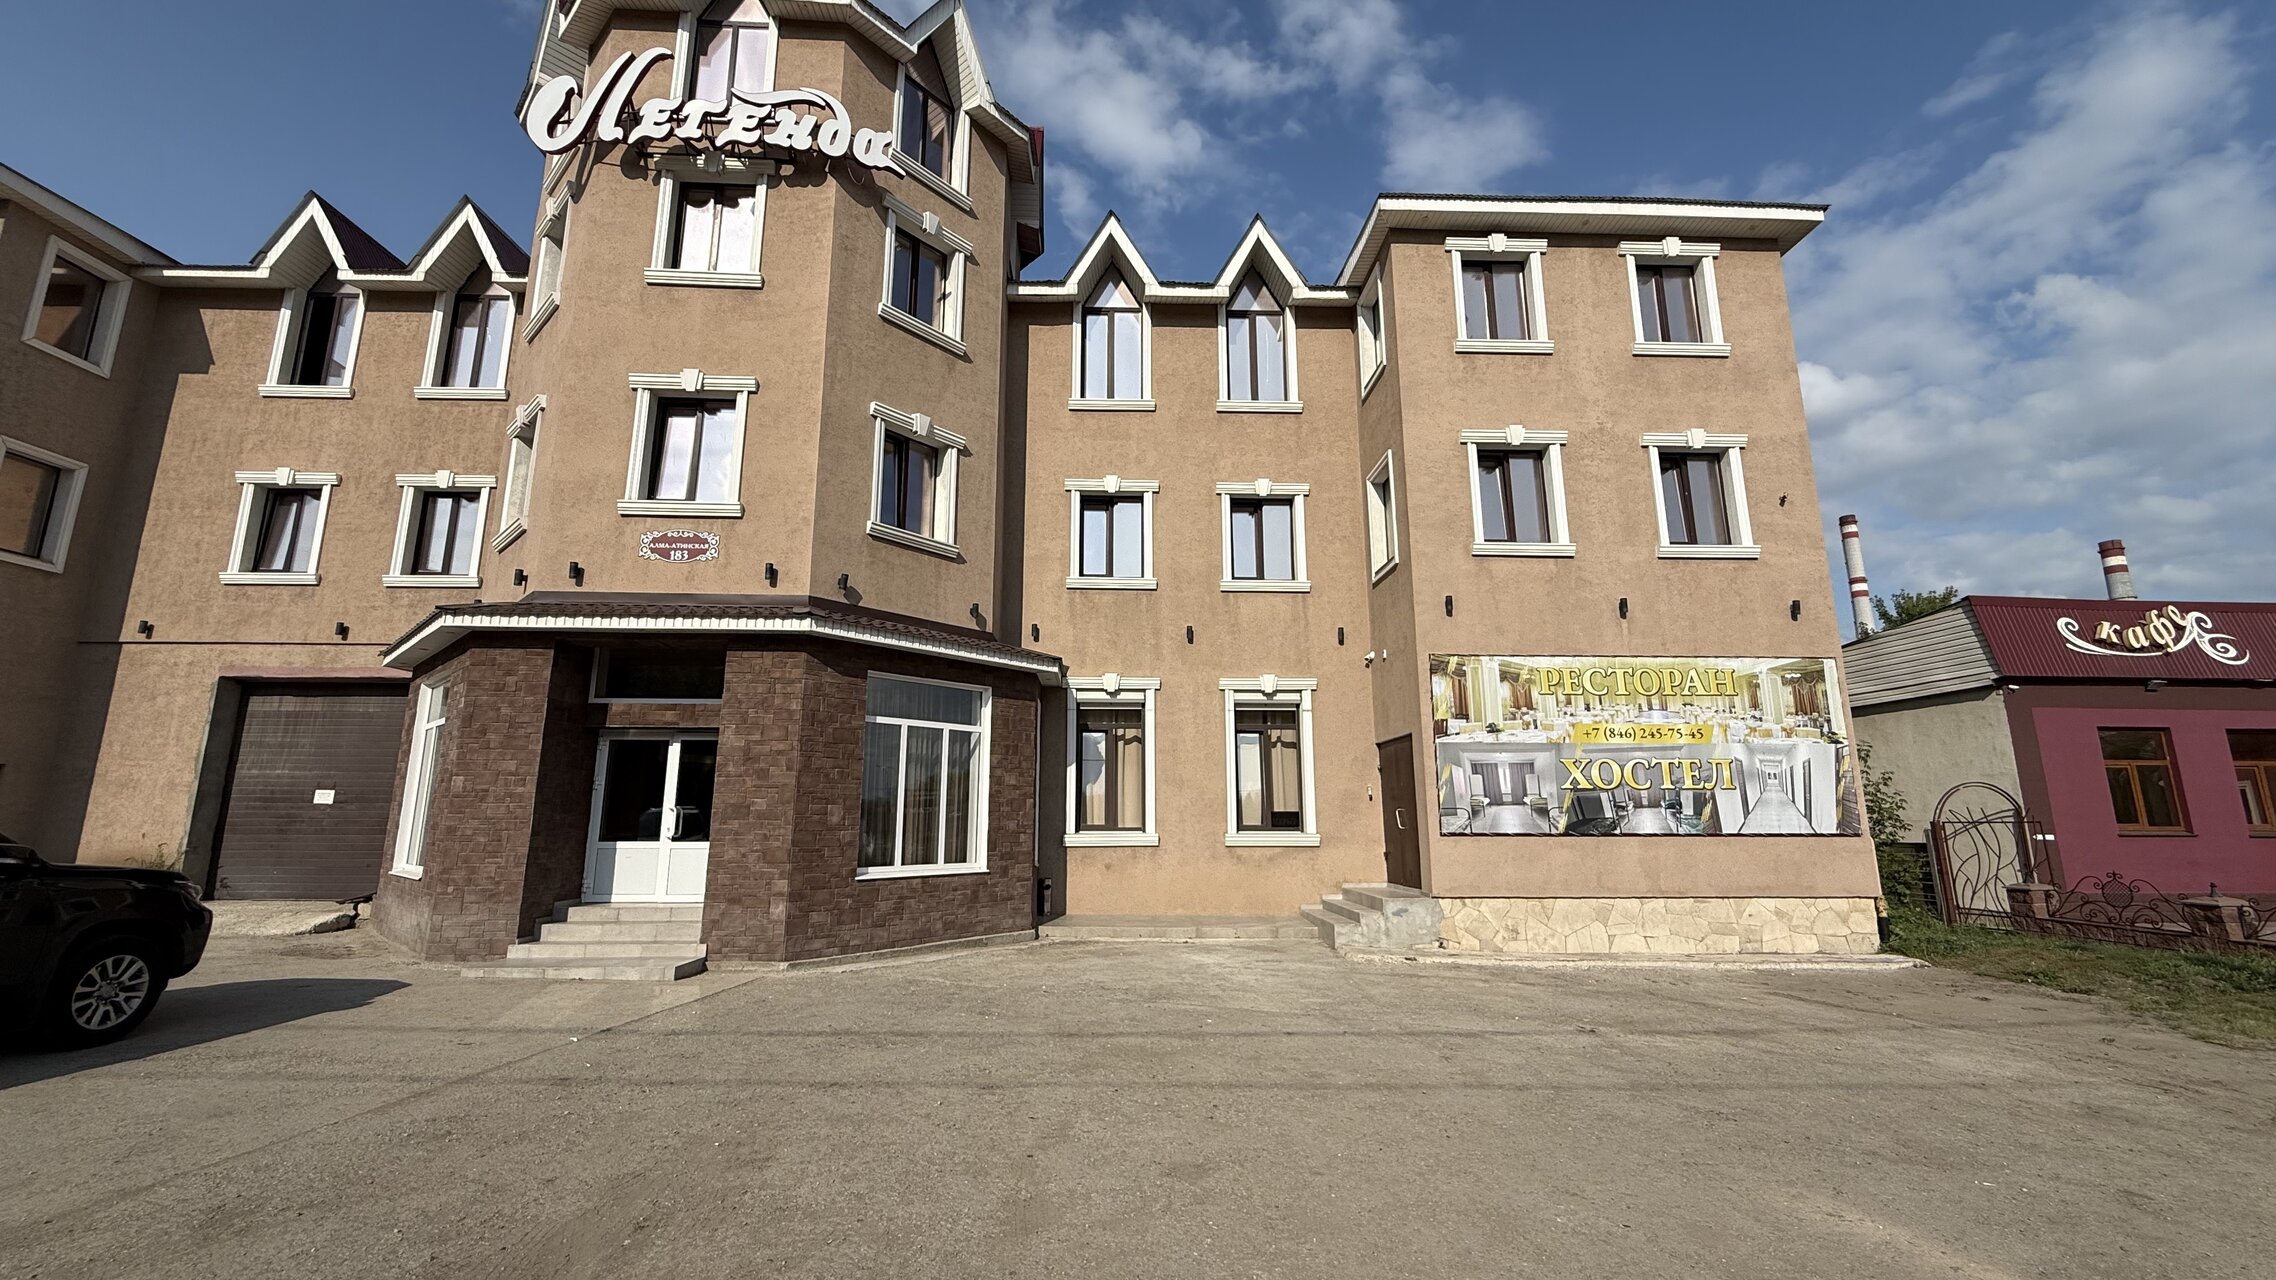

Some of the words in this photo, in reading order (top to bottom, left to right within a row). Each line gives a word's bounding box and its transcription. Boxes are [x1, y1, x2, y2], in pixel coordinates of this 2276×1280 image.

[669, 550, 689, 560] 183
[2094, 604, 2189, 653] кафе
[1537, 667, 1739, 696] РЕСТОРАН
[1583, 727, 1600, 739] +7
[1603, 726, 1637, 741] (846)
[1640, 728, 1704, 739] 245-75-45
[1559, 758, 1737, 790] ХОСТЕЛ
